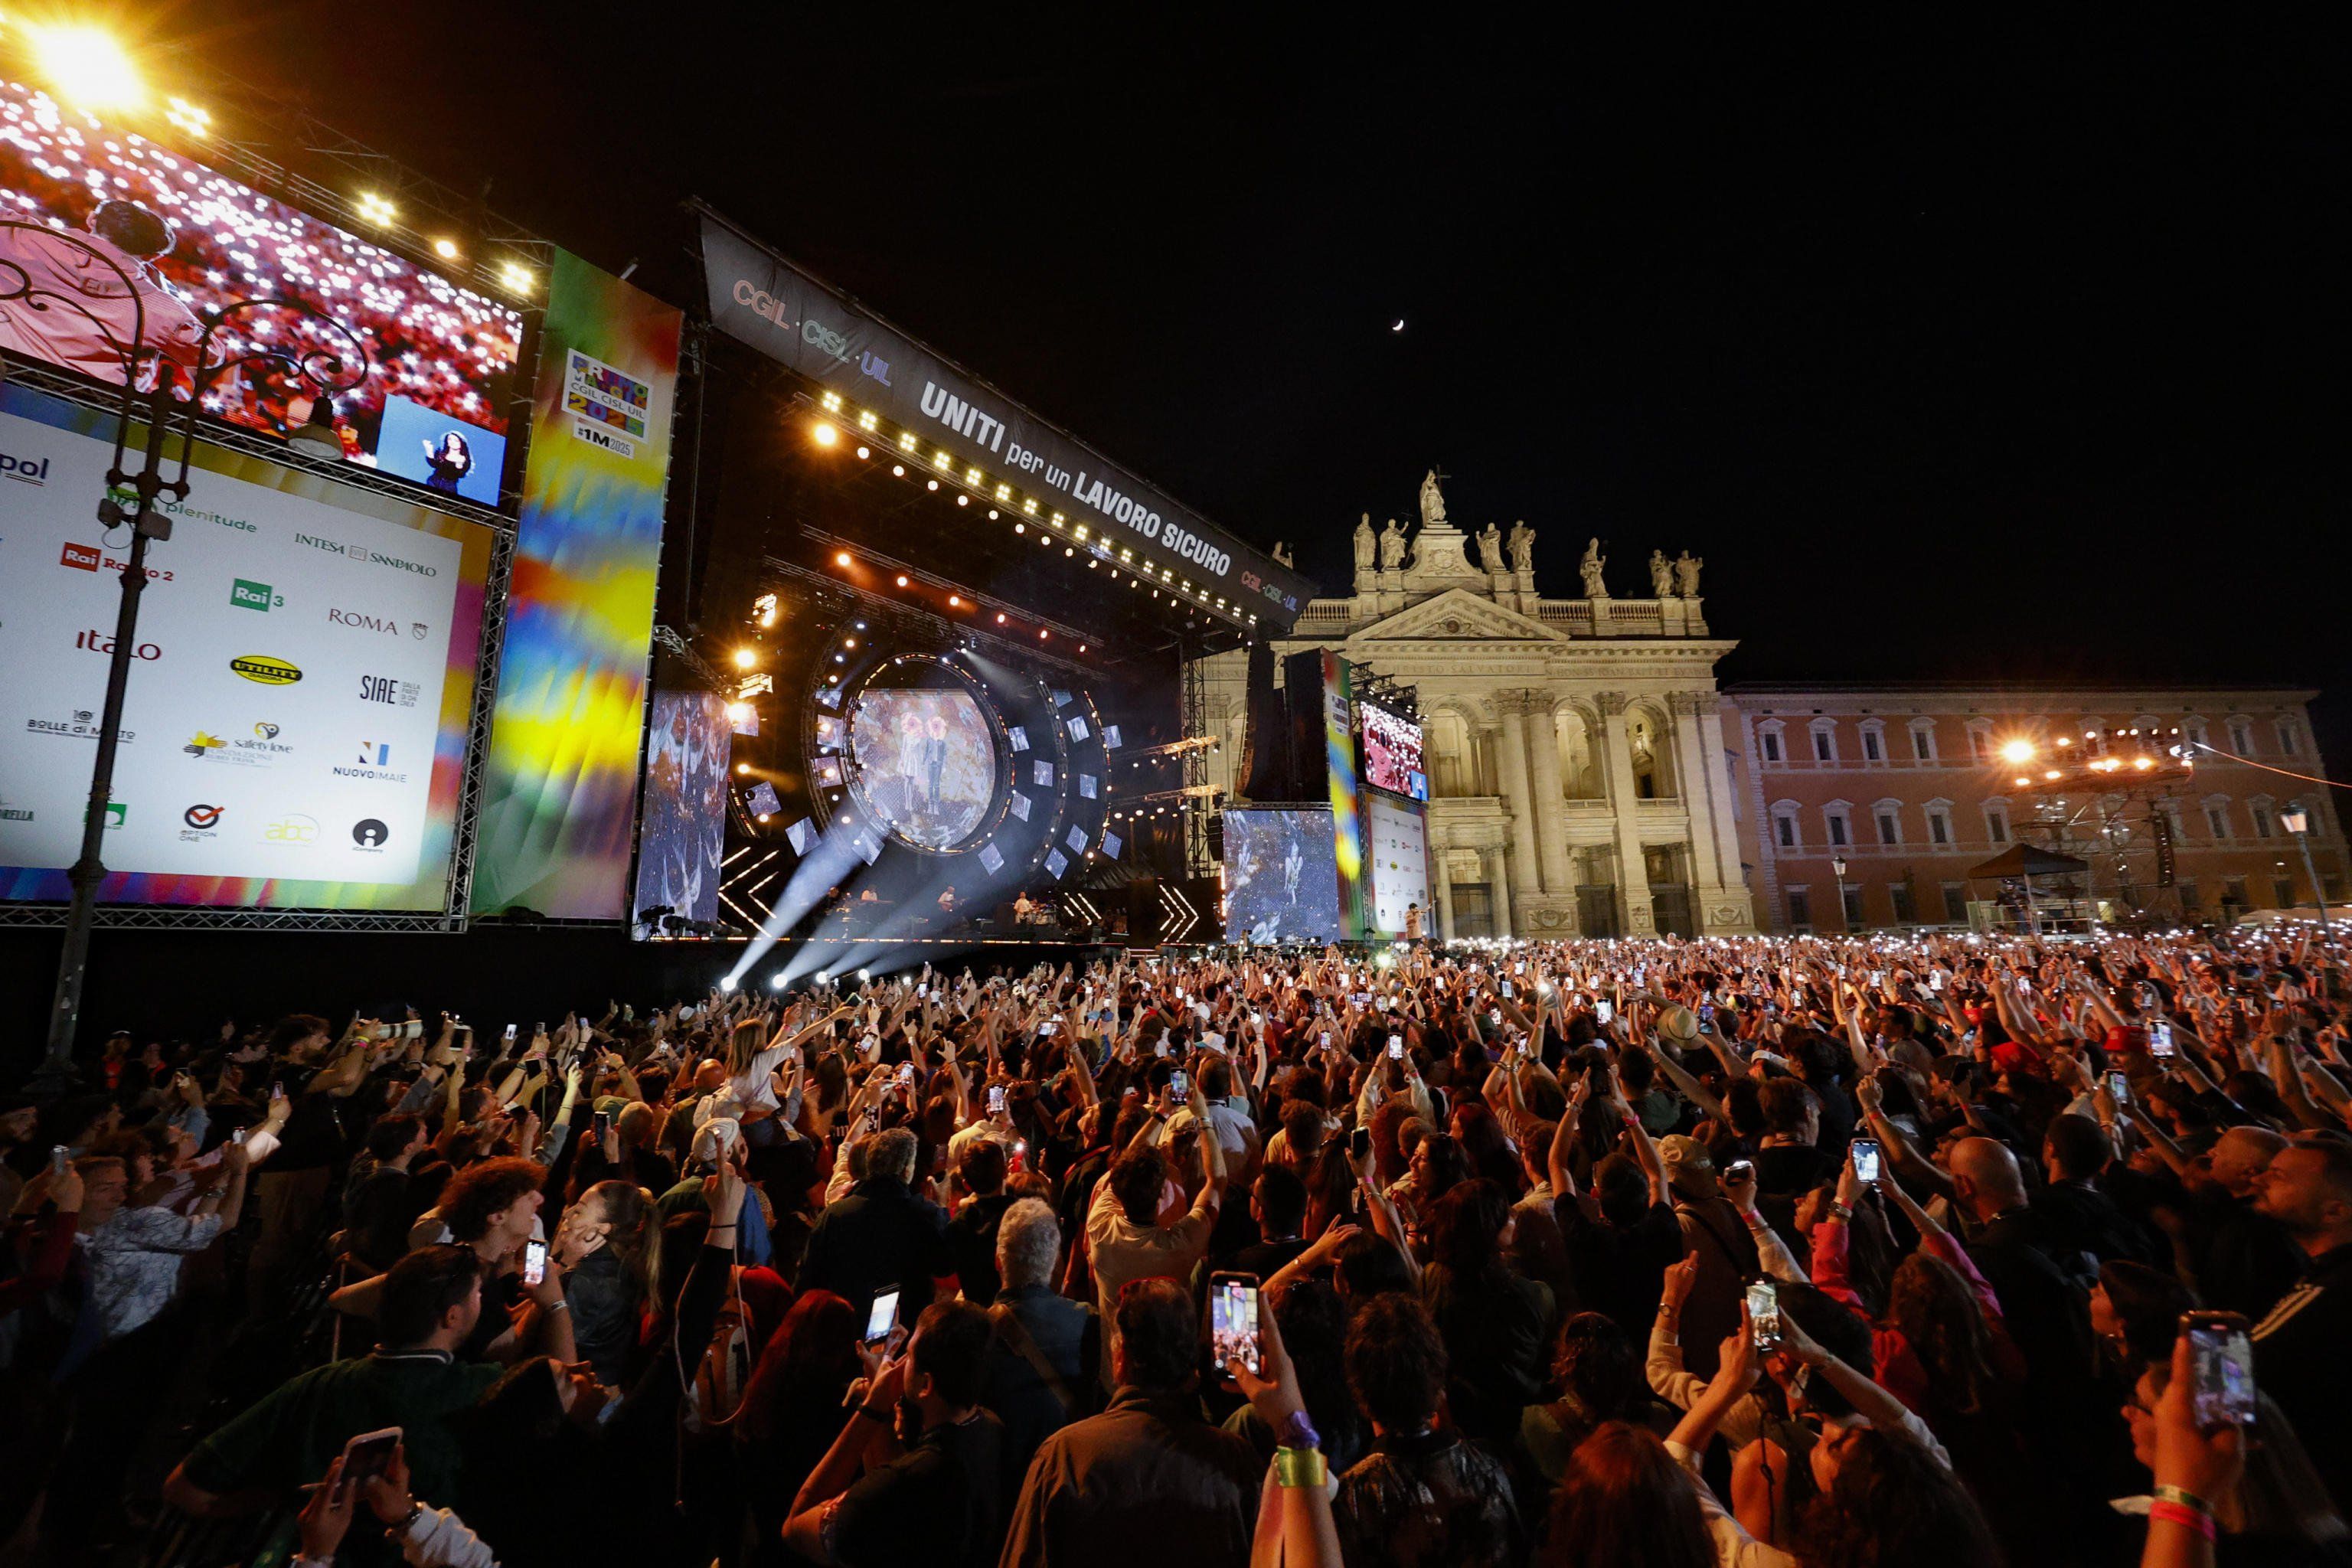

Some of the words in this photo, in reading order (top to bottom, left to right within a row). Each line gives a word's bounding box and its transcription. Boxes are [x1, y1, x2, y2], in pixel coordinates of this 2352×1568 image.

[733, 279, 789, 330] CGIL
[802, 319, 849, 364] CISL
[861, 351, 891, 387] UIL
[568, 393, 645, 438] 2025
[571, 382, 598, 399] CGIL
[601, 395, 625, 410] CISL
[628, 405, 645, 420] UIL
[920, 381, 1005, 453] UNITI
[1004, 442, 1044, 473] per
[1045, 464, 1071, 492] un
[1073, 472, 1161, 538] LAVORO
[1161, 522, 1231, 577] SICURO
[165, 504, 256, 532] plenitude
[65, 549, 97, 565] Rai
[103, 557, 159, 577] Raio
[163, 570, 174, 581] 2
[295, 533, 345, 554] INTESA
[371, 552, 436, 577] SANPAOLO
[235, 586, 268, 604] Rai
[273, 596, 284, 607] 3
[329, 609, 398, 635] ROMA
[77, 629, 162, 660] itao
[360, 675, 398, 704] SIAE
[28, 719, 69, 731] BOLLE
